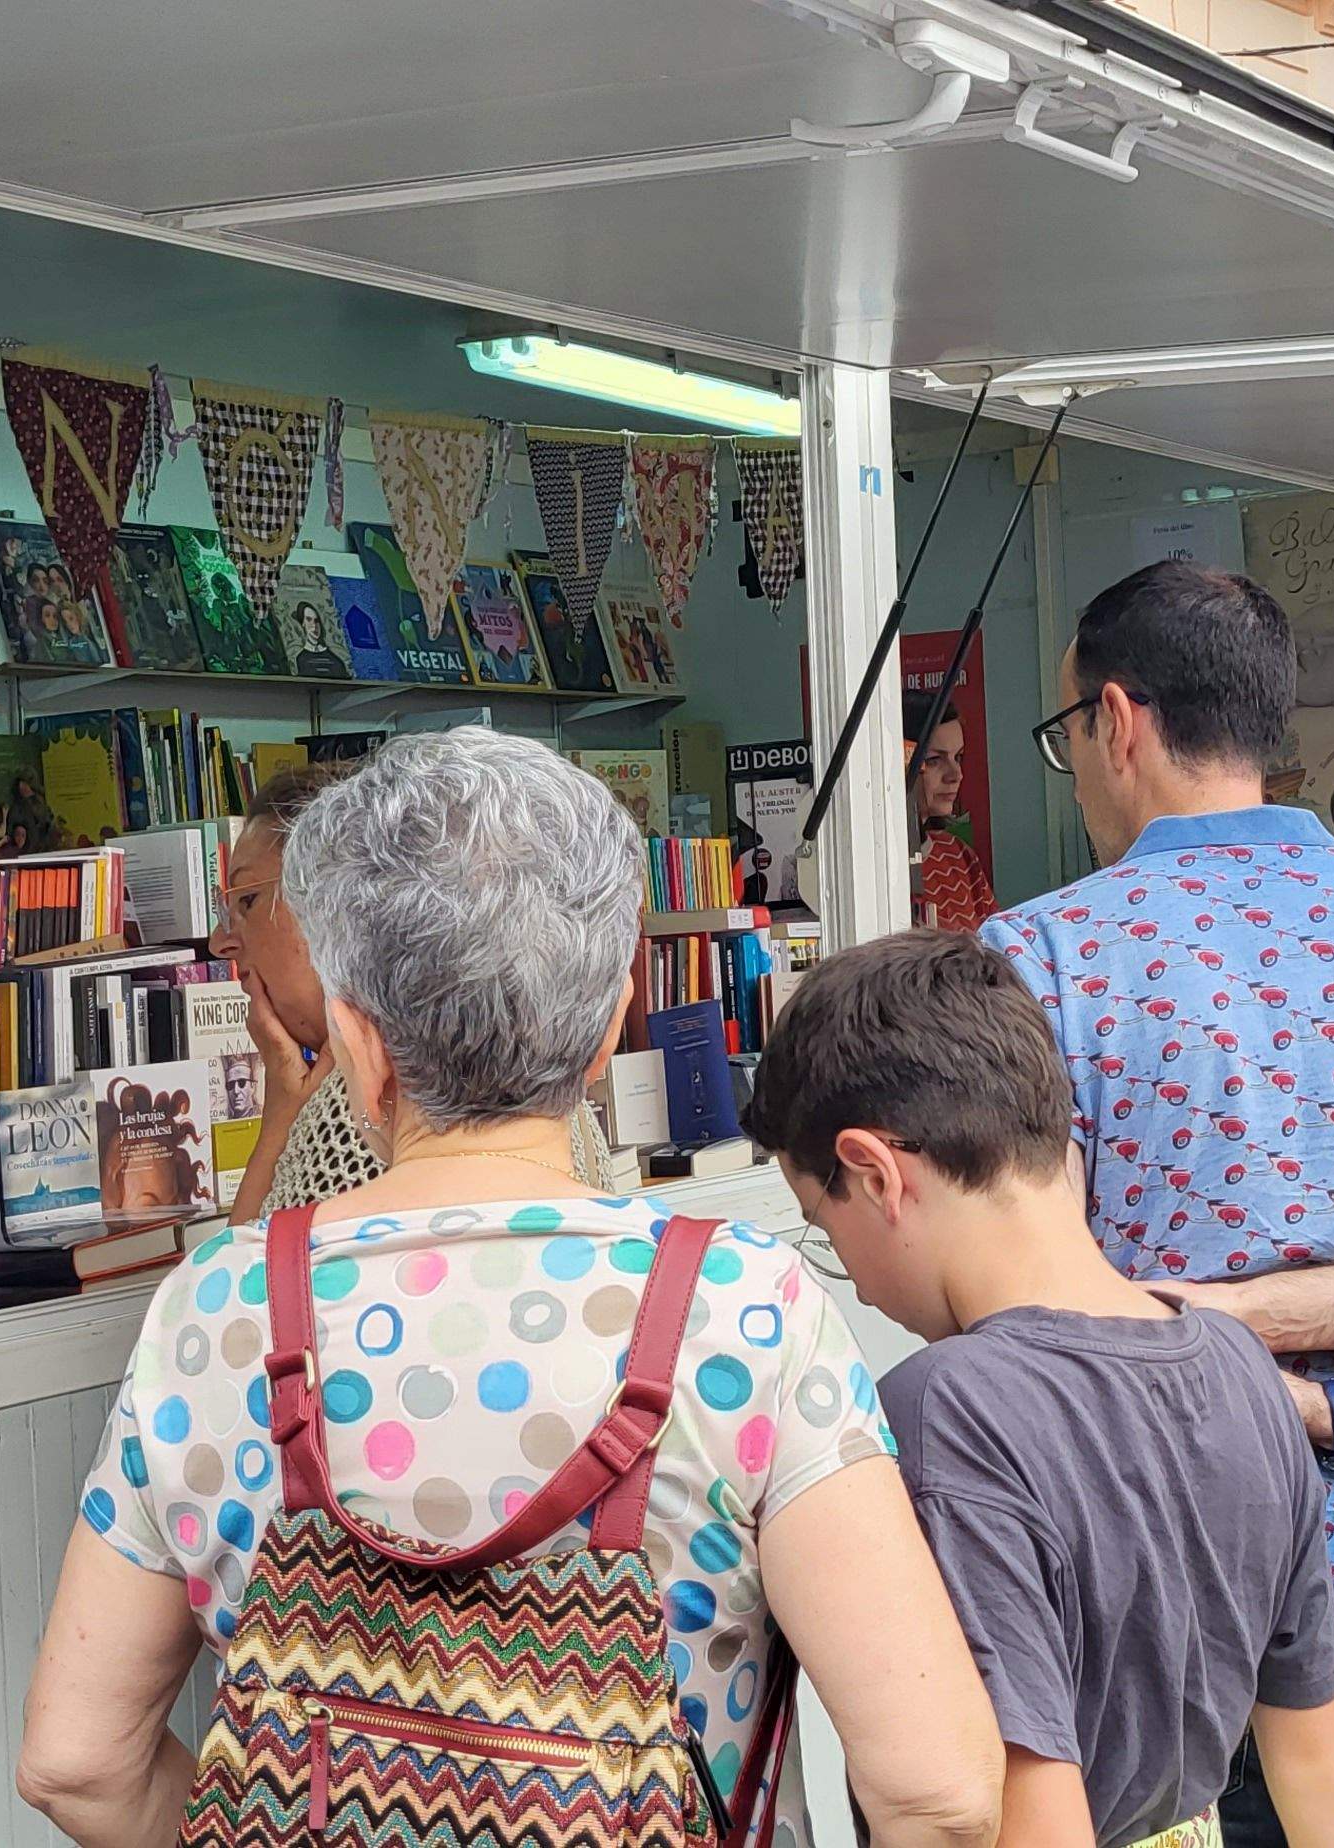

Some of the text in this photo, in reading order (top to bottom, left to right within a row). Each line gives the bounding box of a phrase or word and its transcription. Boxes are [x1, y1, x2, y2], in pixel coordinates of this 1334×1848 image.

[396, 649, 466, 671] VEGETAL
[673, 729, 683, 798] trucción
[752, 745, 813, 769] DeBO
[193, 1001, 251, 1027] KING COR
[20, 1098, 78, 1121] DONNA
[119, 1109, 166, 1126] Las brujas
[7, 1115, 92, 1155] LEON
[127, 1127, 137, 1140] la
[138, 1123, 172, 1138] condesa
